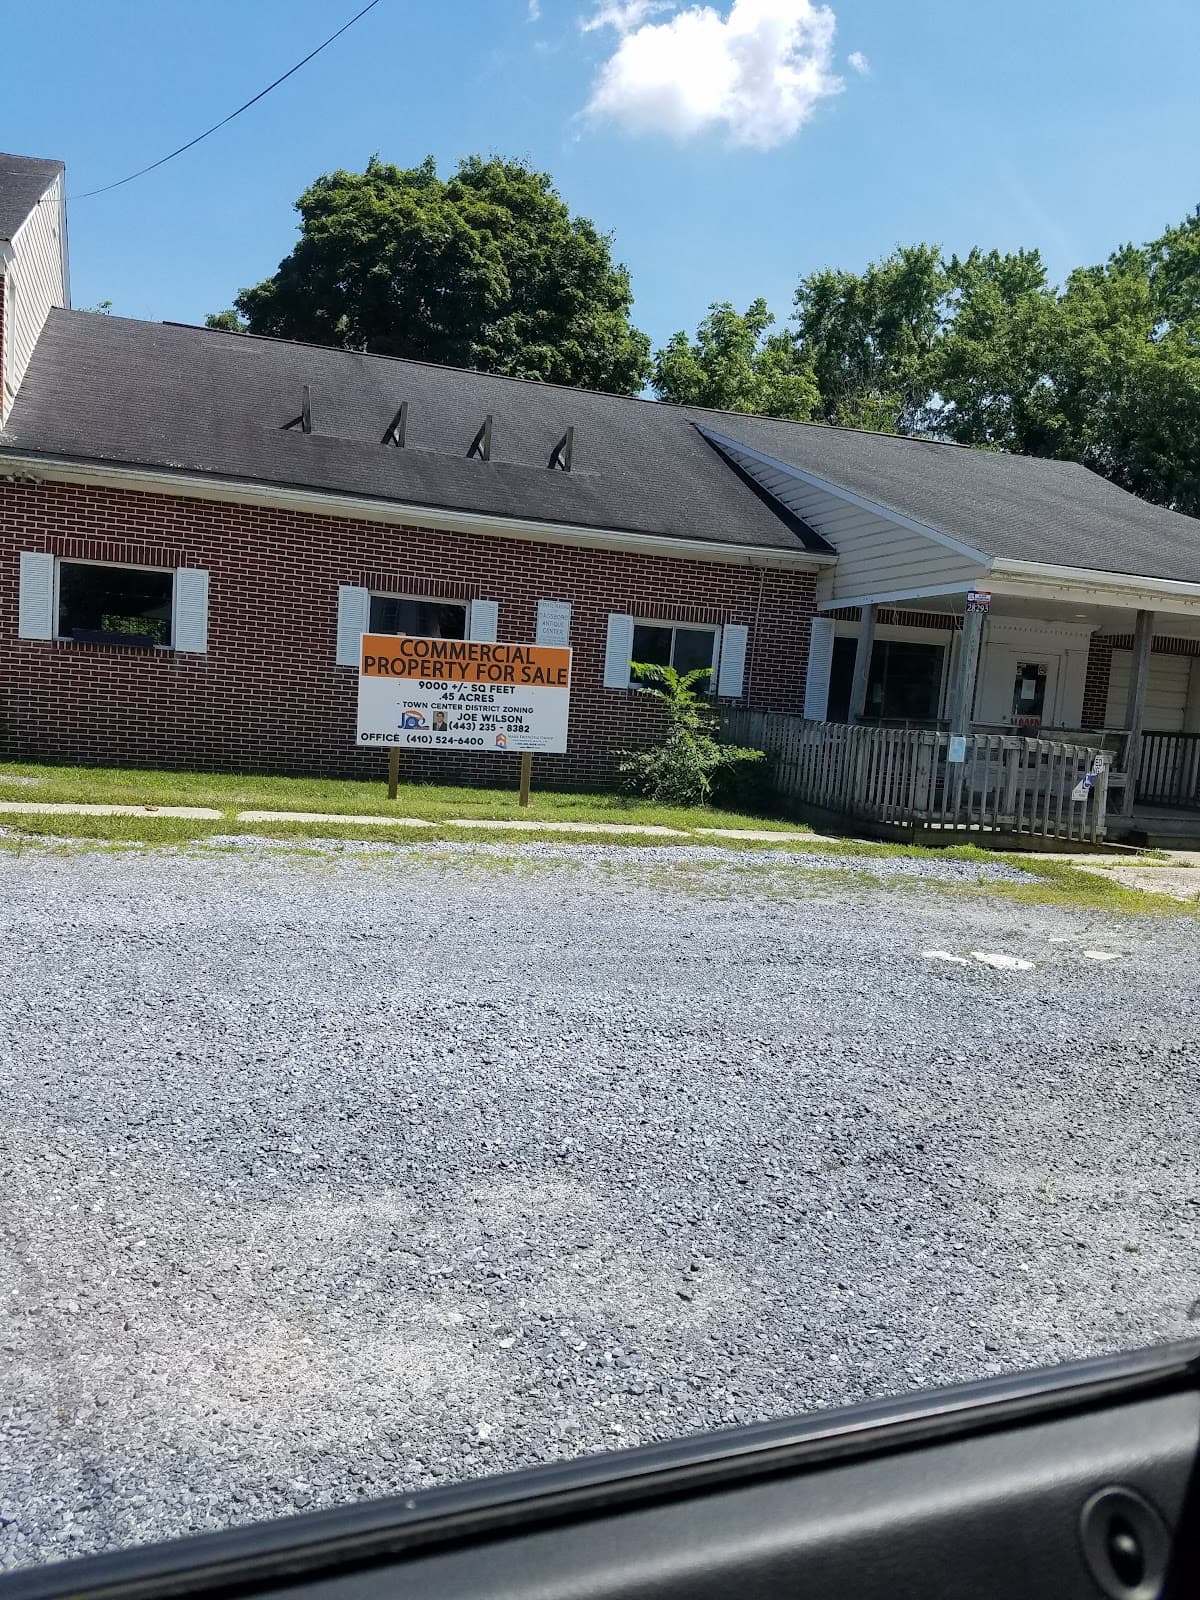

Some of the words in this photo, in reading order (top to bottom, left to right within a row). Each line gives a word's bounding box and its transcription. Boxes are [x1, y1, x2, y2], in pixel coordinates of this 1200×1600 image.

[400, 639, 536, 665] COMMERCIAL
[363, 655, 471, 680] PROPERTY
[476, 663, 514, 682] FOR
[520, 666, 567, 685] SALE
[418, 680, 448, 691] 9000
[451, 683, 468, 692] +/-
[471, 684, 486, 693] SQ
[489, 685, 516, 694] FEET
[458, 693, 495, 703] ACRES
[402, 701, 428, 709] TOWN
[430, 702, 463, 711] CENTER
[465, 704, 501, 713] DISTRICT
[502, 706, 534, 714] ZONING
[457, 713, 478, 722] JOE
[481, 714, 523, 724] WILSON
[448, 720, 476, 731] (443)
[479, 723, 496, 732] 235
[506, 724, 530, 733] 8382
[360, 732, 400, 742] OFFICE
[406, 734, 433, 745] (410)
[435, 736, 484, 746] 524-6400
